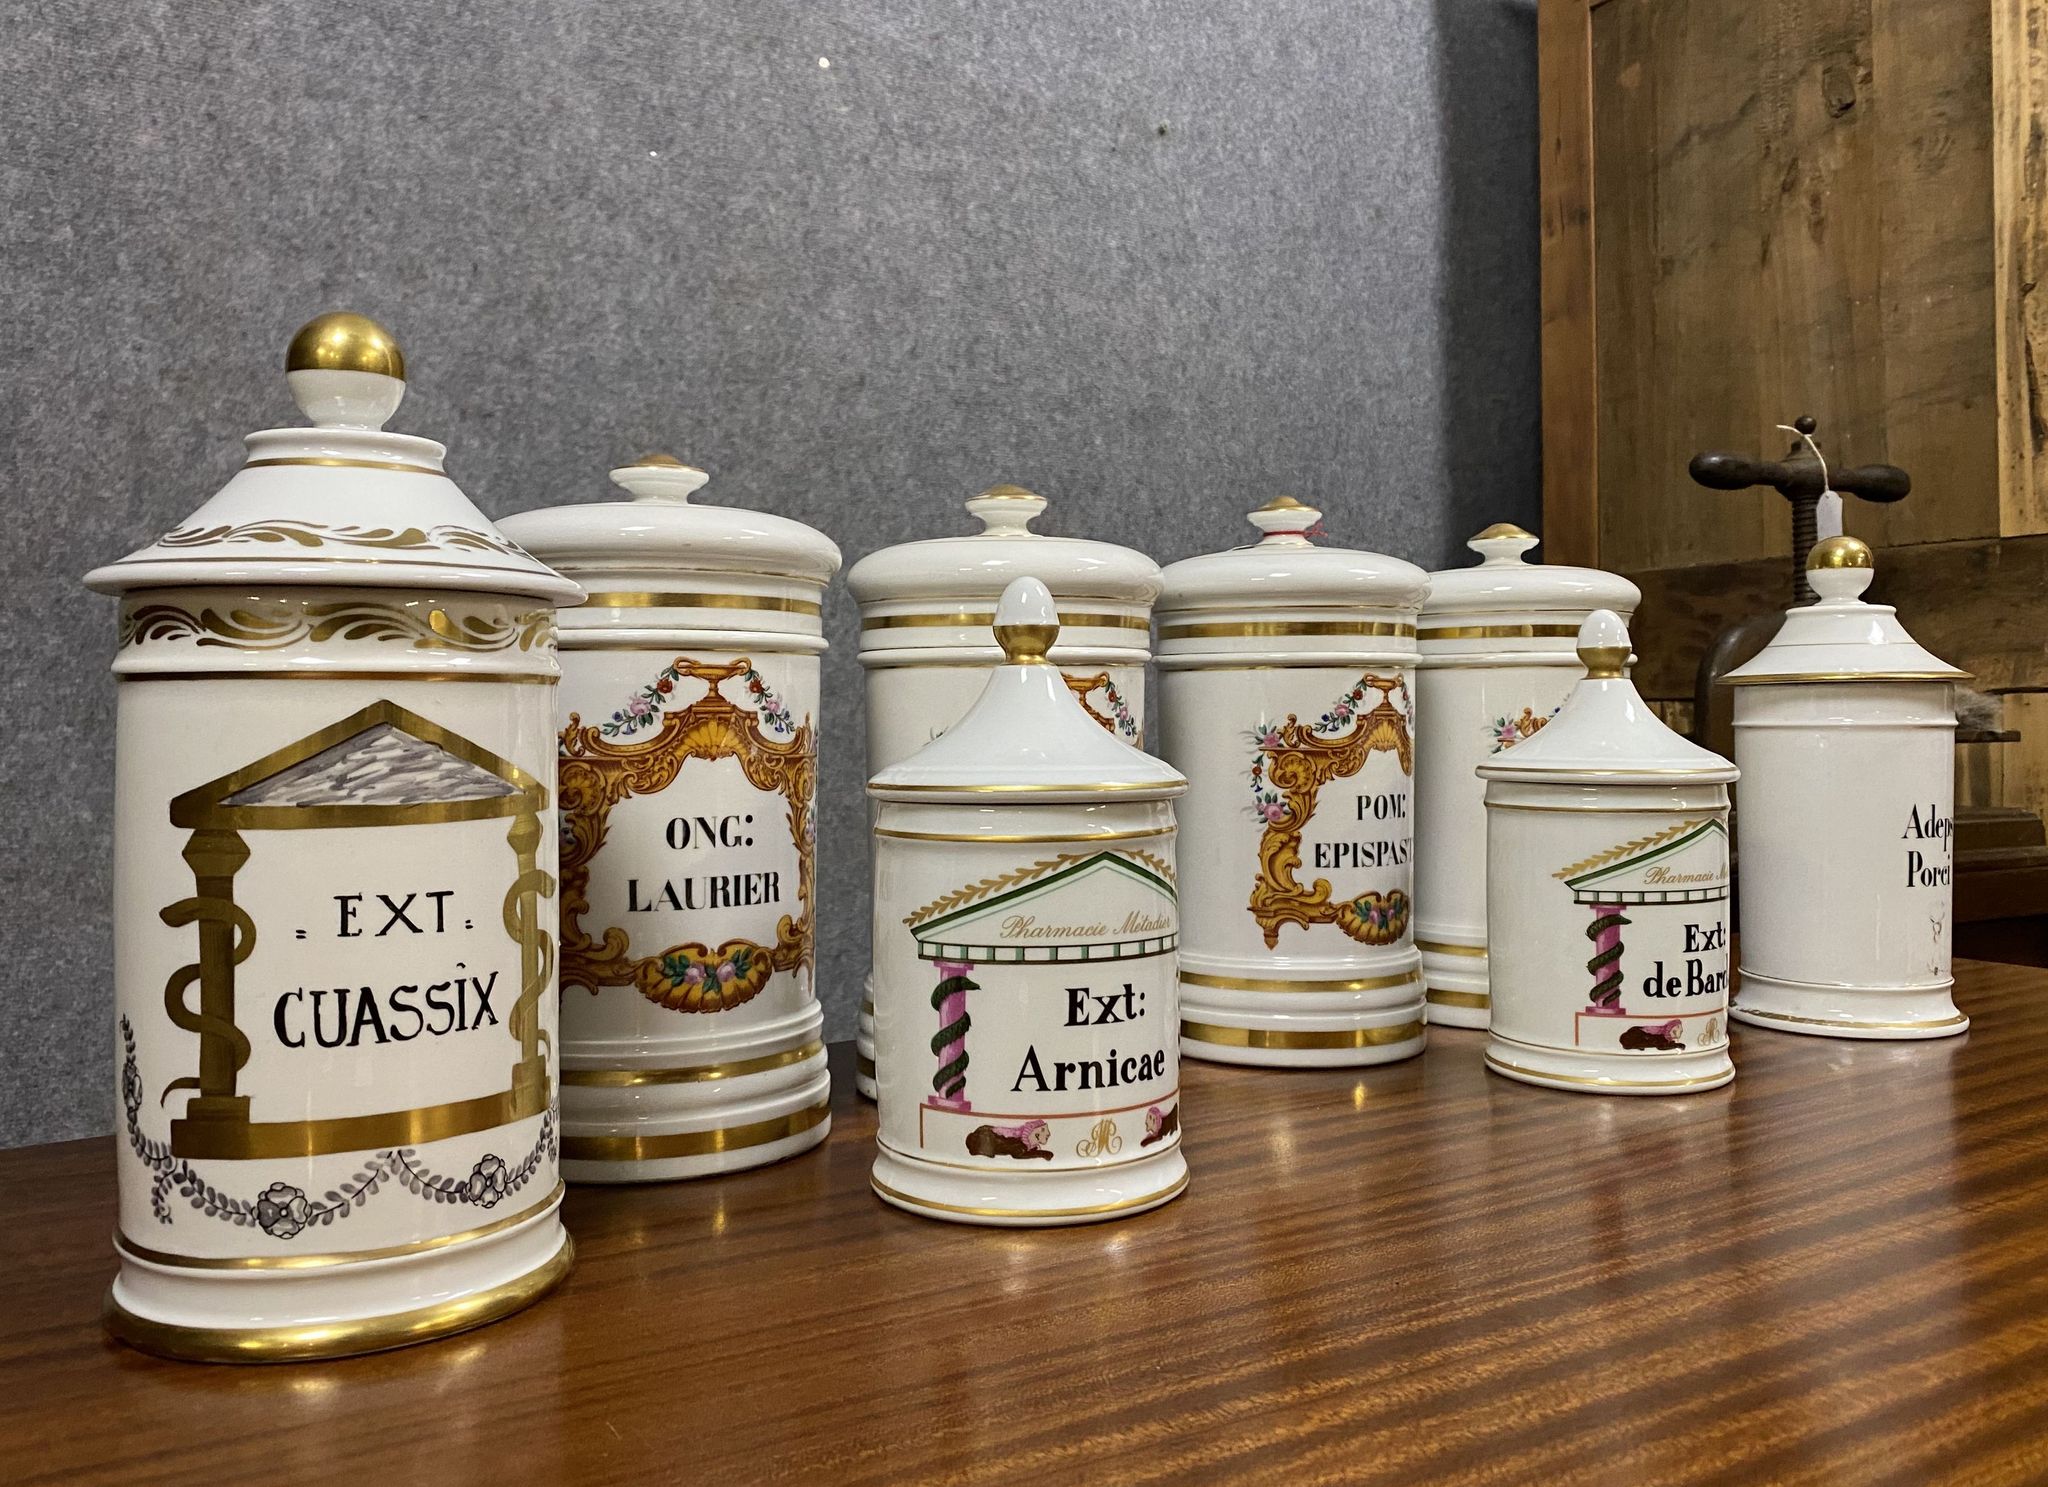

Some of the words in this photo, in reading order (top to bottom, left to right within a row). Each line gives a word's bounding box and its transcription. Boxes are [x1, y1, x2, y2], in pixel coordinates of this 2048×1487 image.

[665, 814, 754, 850] ONG:
[626, 871, 781, 913] LAURIER
[1000, 914, 1108, 939] Pharmacie
[1642, 960, 1682, 999] de
[1063, 983, 1146, 1028] Ext:
[1010, 1044, 1165, 1093] Arnicae
